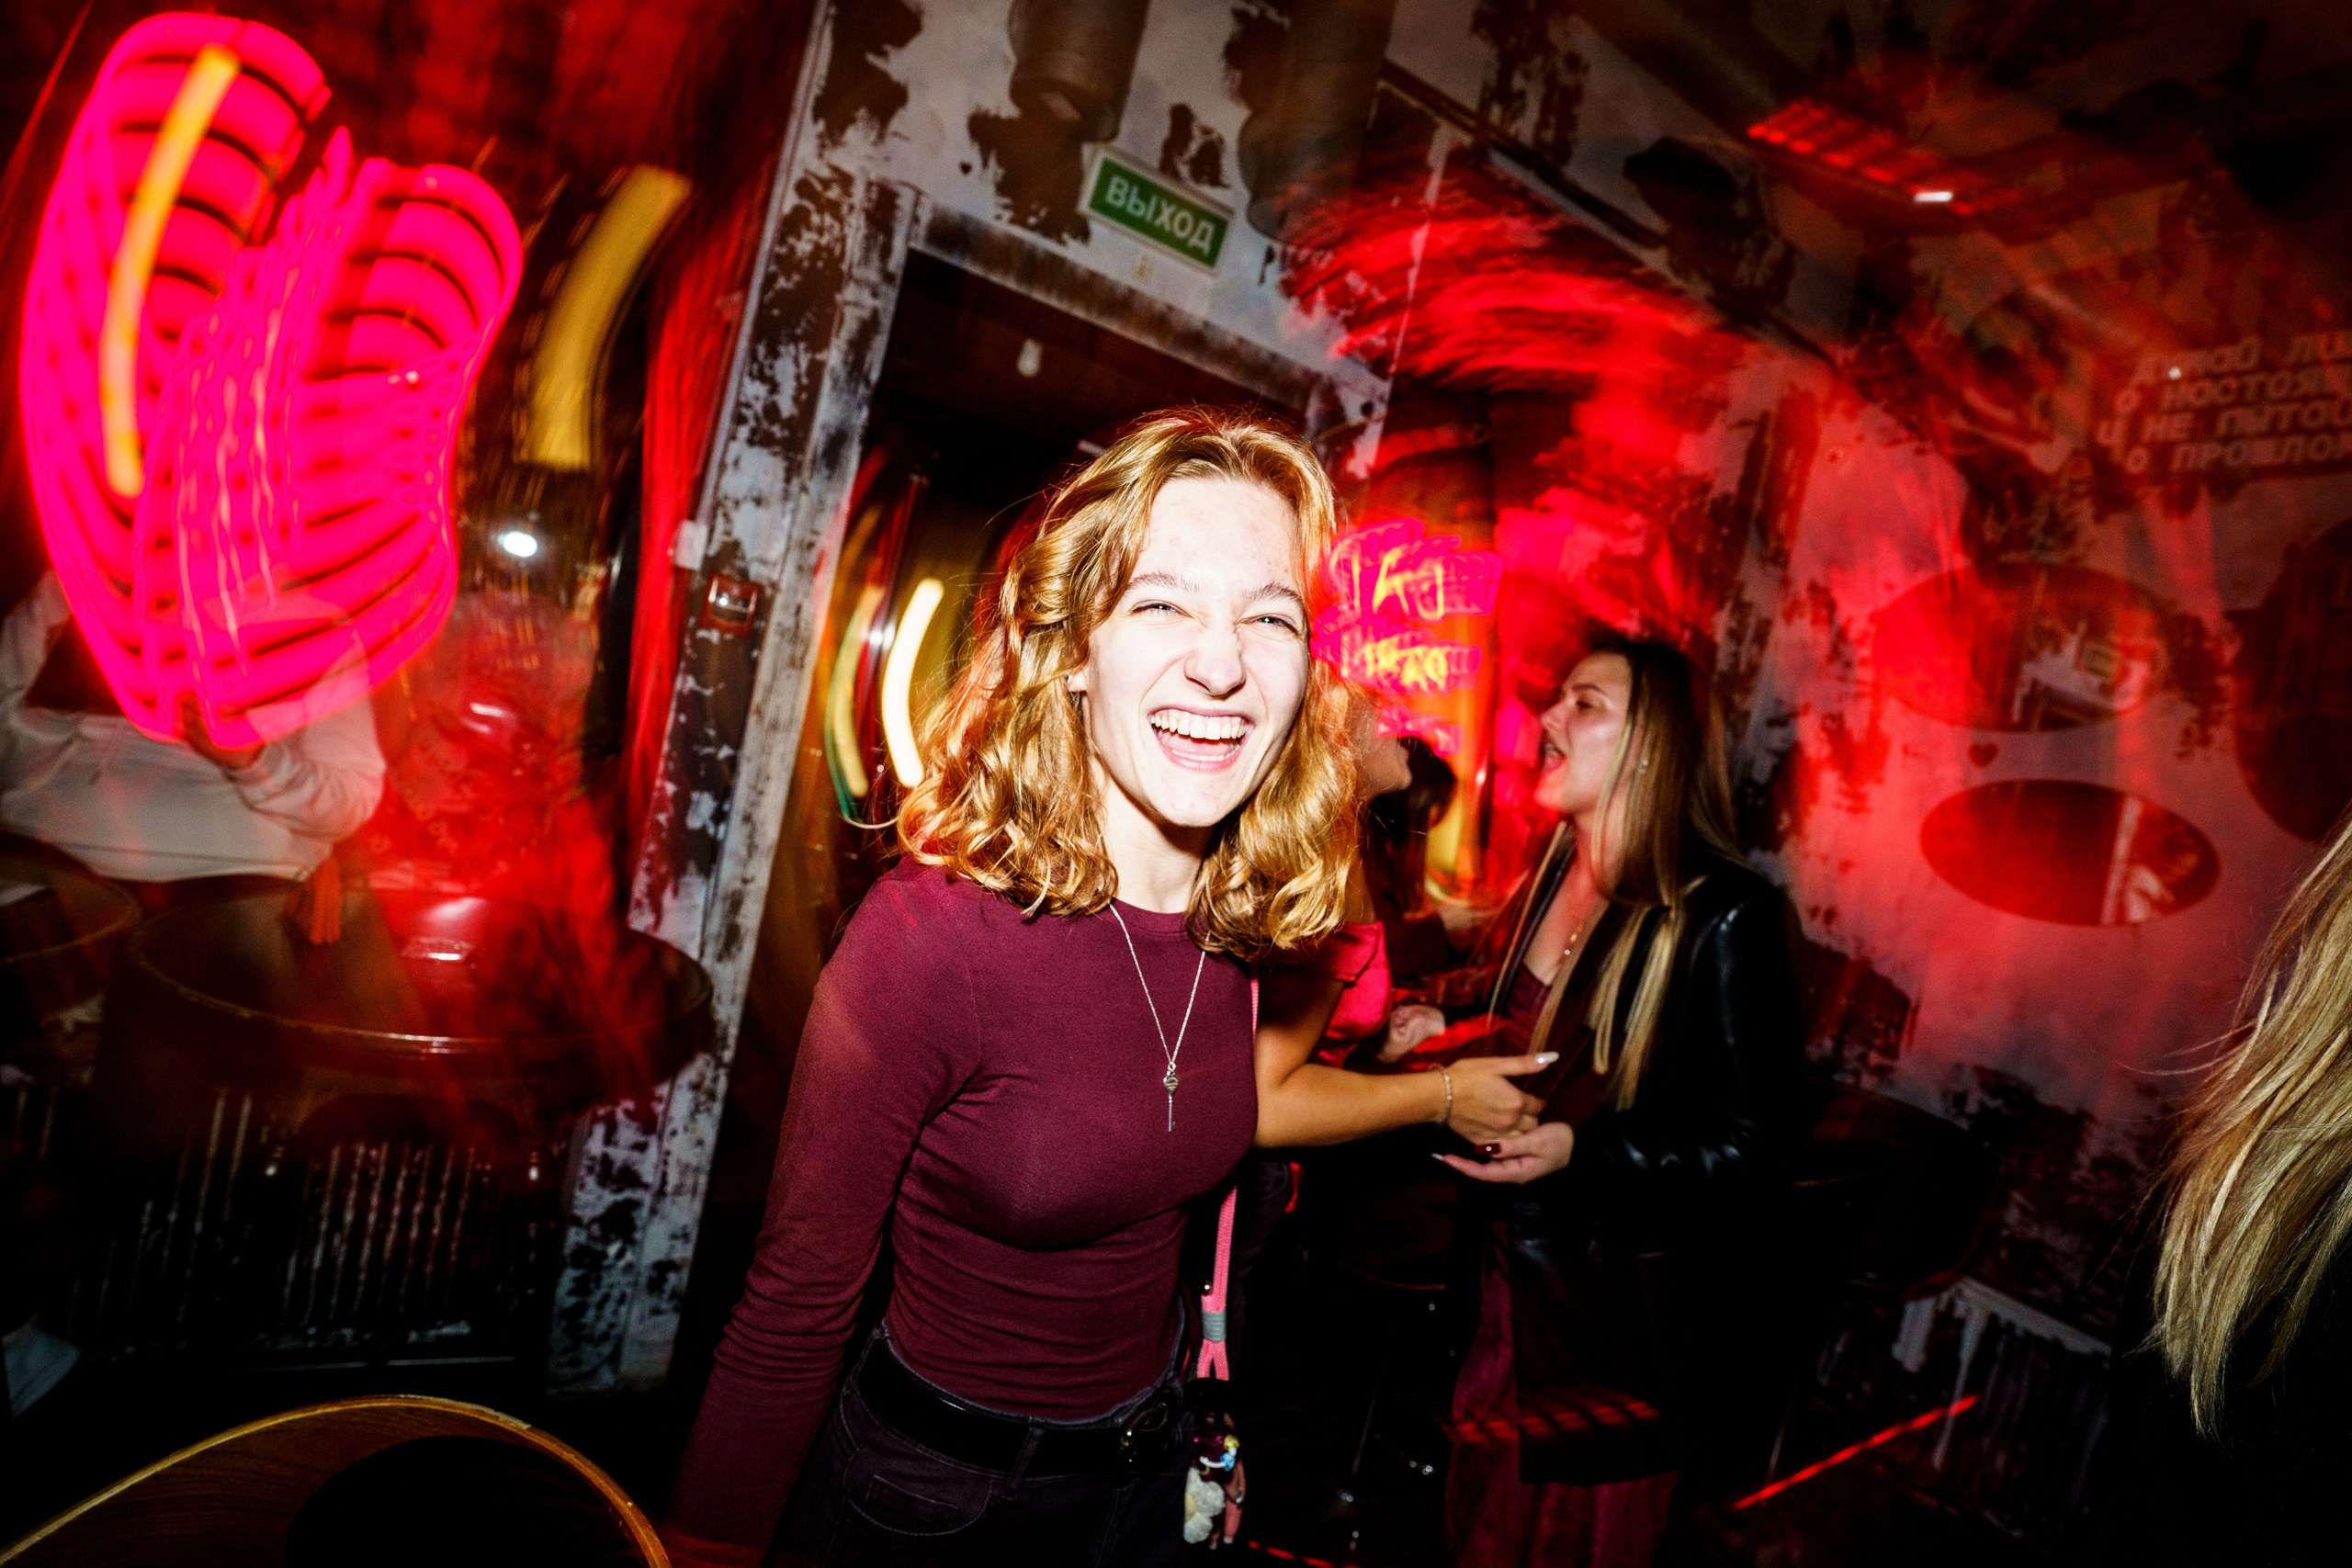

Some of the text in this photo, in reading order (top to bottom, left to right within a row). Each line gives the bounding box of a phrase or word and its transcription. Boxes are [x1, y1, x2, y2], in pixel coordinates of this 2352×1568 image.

[1104, 174, 1216, 255] ВЫХОД
[2143, 412, 2193, 441] НЕ
[2126, 446, 2149, 474] О
